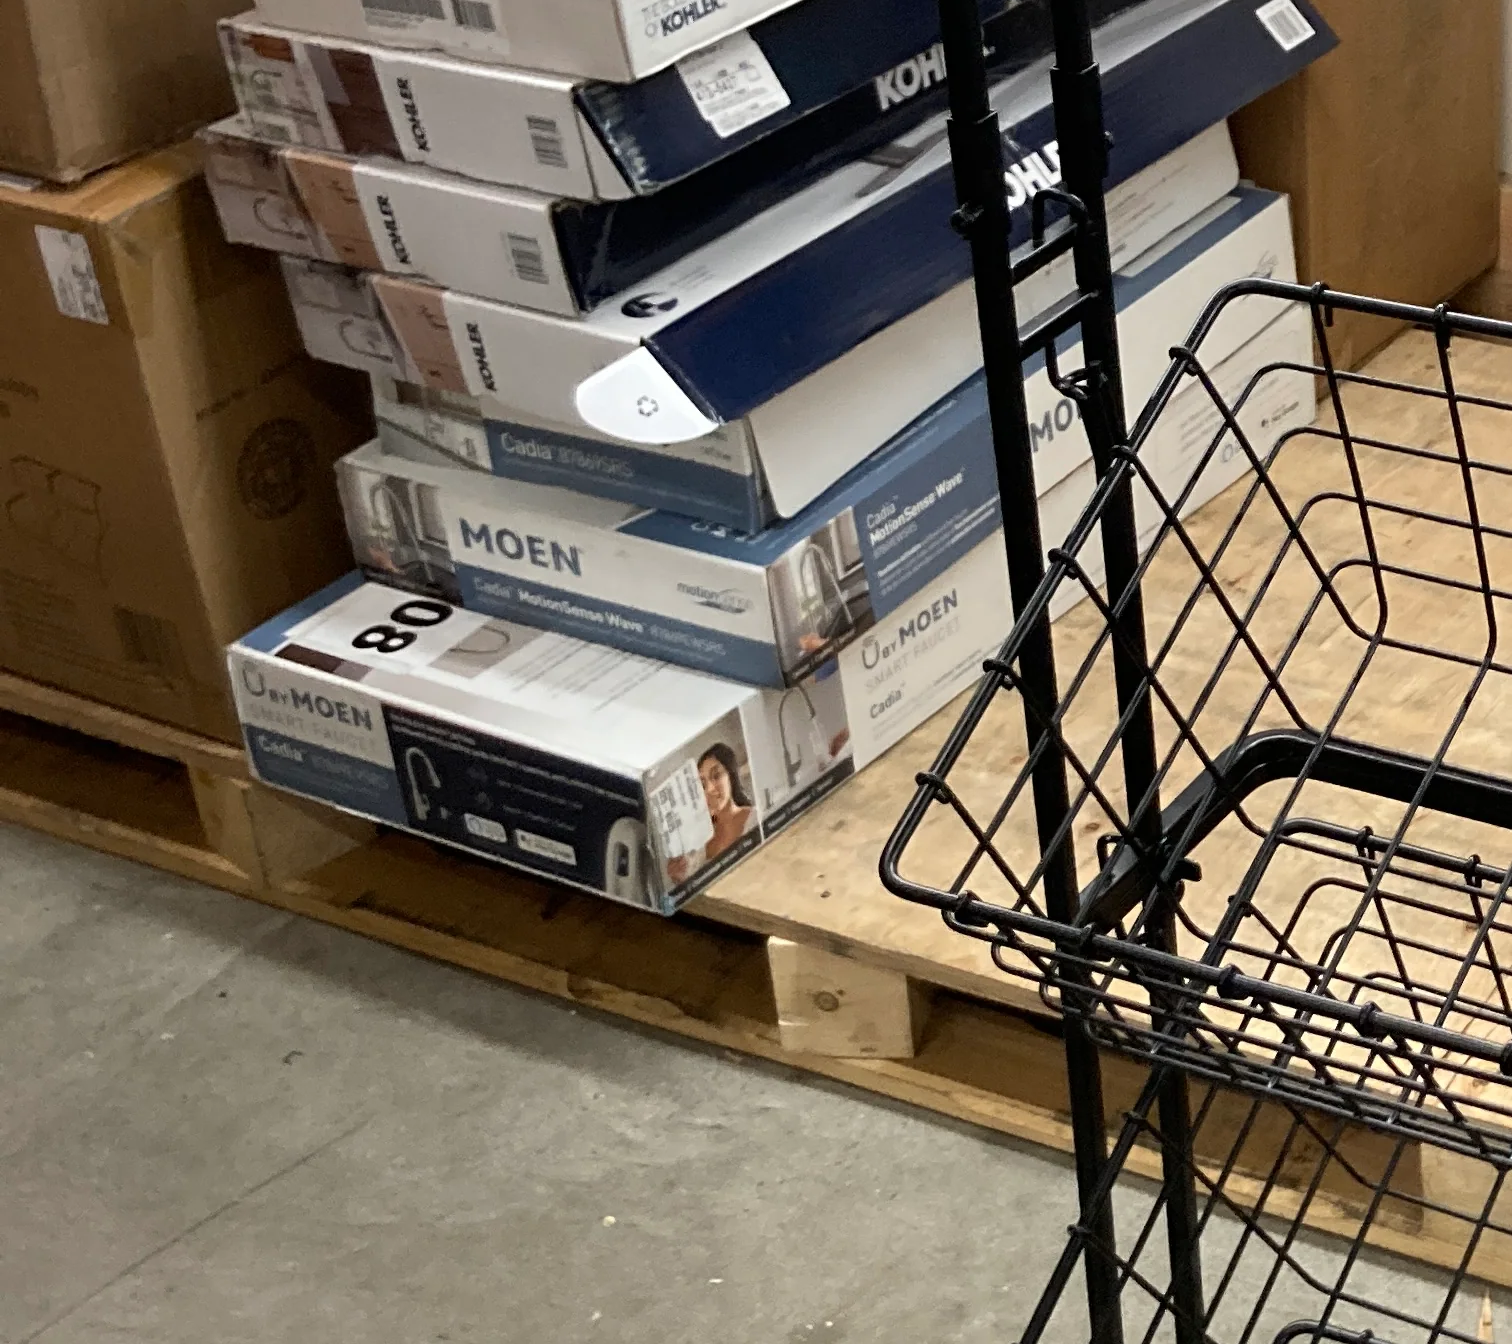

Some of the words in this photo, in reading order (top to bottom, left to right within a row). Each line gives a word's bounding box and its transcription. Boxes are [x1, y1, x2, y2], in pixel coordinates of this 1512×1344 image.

[398, 77, 430, 152] KOHLER
[376, 194, 411, 264] KOHLER
[466, 322, 497, 391] KOHLER
[501, 433, 553, 460] Cadia
[867, 503, 896, 529] Cadia
[459, 517, 582, 577] MOEN
[604, 611, 645, 633] Wave
[899, 588, 958, 646] MOEN
[290, 688, 372, 731] MOEN
[870, 689, 902, 719] Cadia
